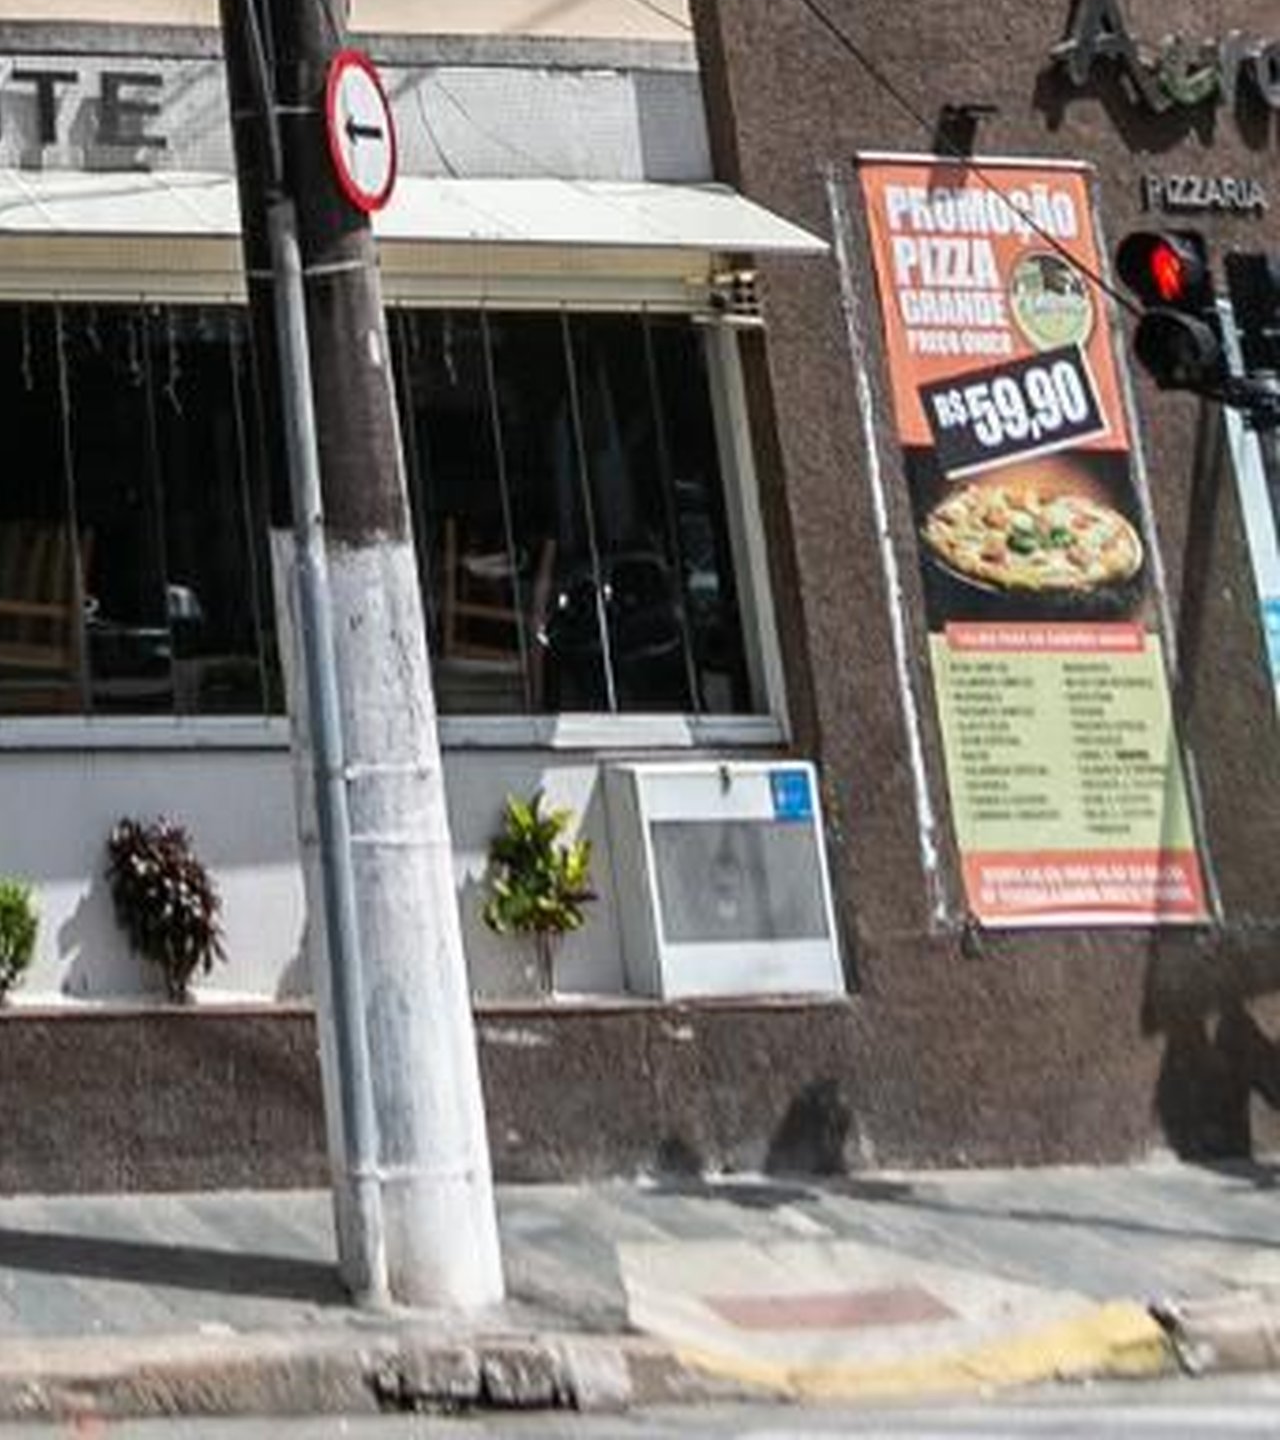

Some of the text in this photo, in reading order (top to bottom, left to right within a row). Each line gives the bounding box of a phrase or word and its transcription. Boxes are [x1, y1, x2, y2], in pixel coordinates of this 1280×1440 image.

[885, 181, 1078, 243] PROMOÇÃO
[1146, 175, 1270, 211] PIZZARIA
[892, 235, 1000, 287] PIZZA
